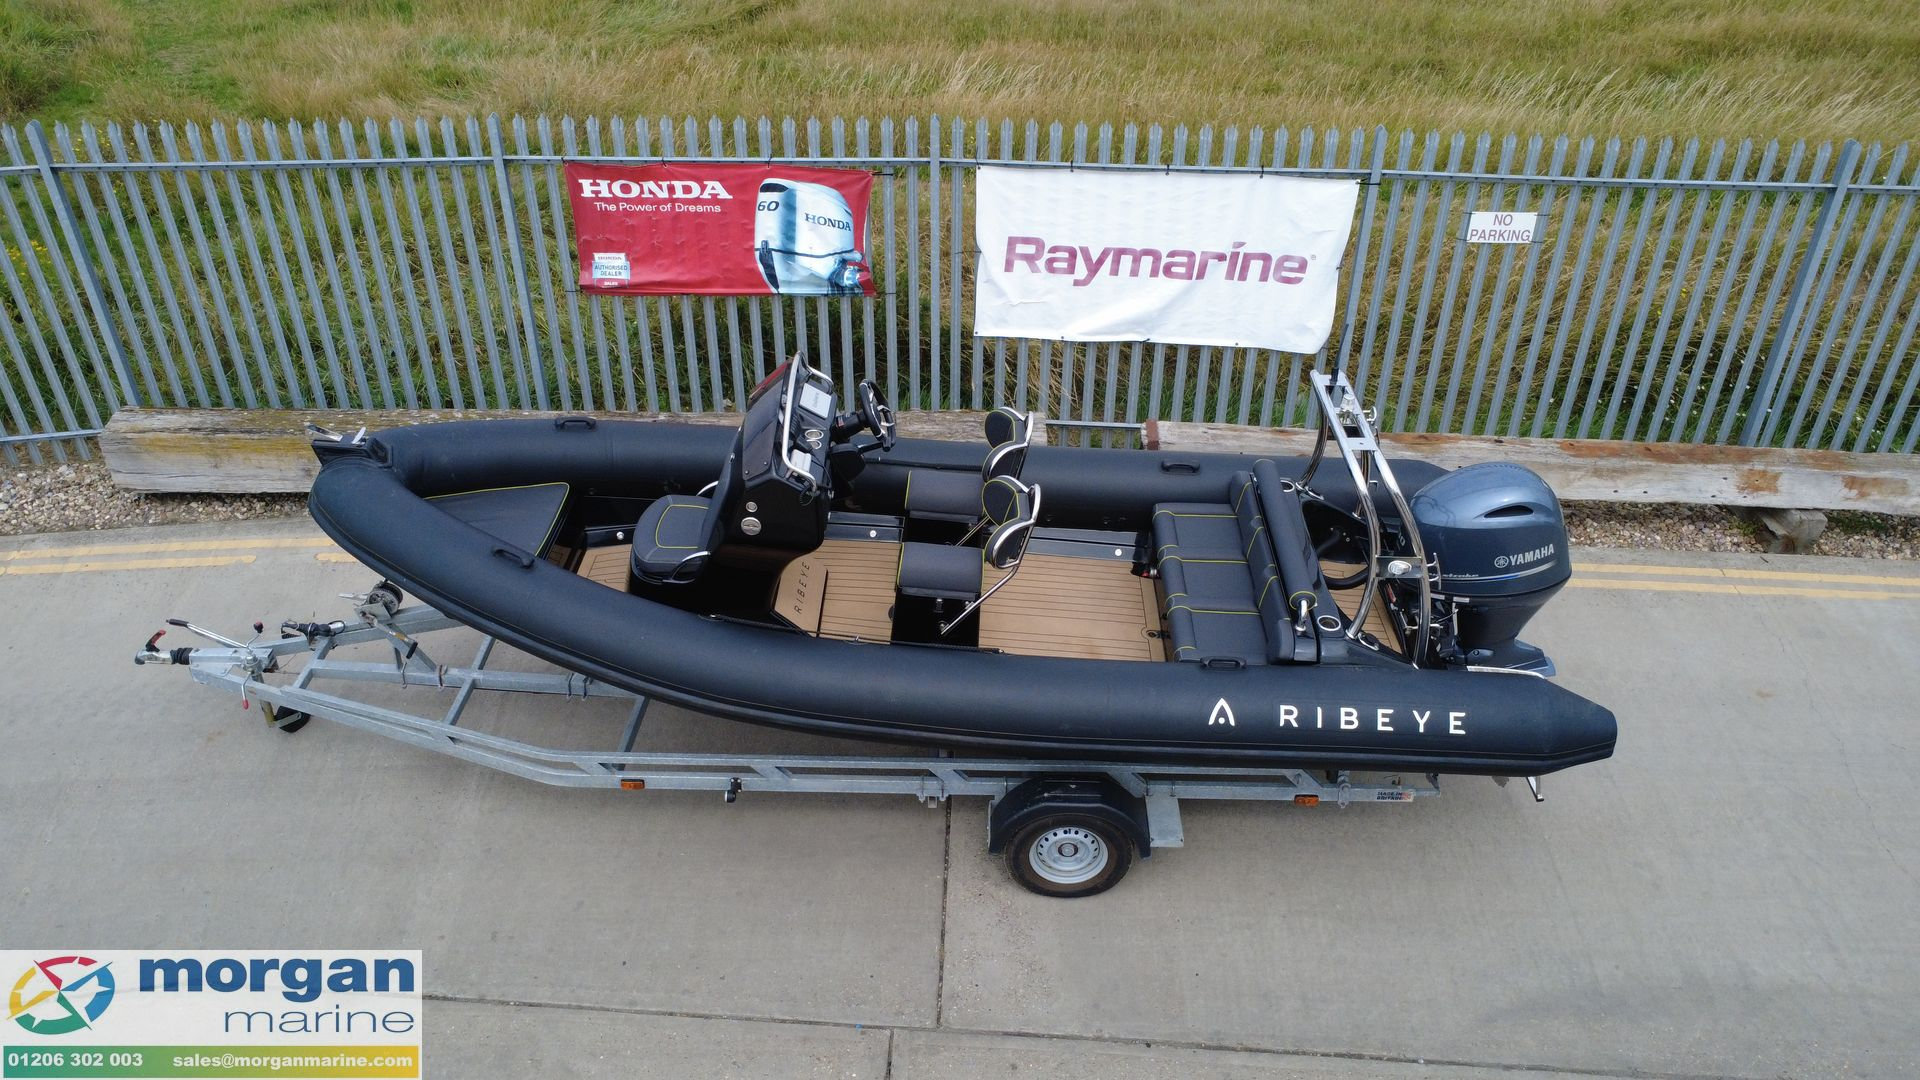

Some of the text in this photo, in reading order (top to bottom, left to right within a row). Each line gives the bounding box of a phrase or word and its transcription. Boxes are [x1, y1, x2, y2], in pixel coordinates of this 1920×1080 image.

[578, 179, 733, 199] HONDA
[594, 202, 721, 213] The Power of Dreams
[757, 200, 780, 212] 60
[804, 212, 851, 231] HONDA
[1493, 214, 1513, 226] NO
[1469, 229, 1531, 241] PARKING
[1004, 236, 1308, 287] Raymarine
[1509, 543, 1554, 566] YAMAHA
[793, 561, 810, 614] RIBEYE
[1279, 705, 1466, 735] RIBEYE
